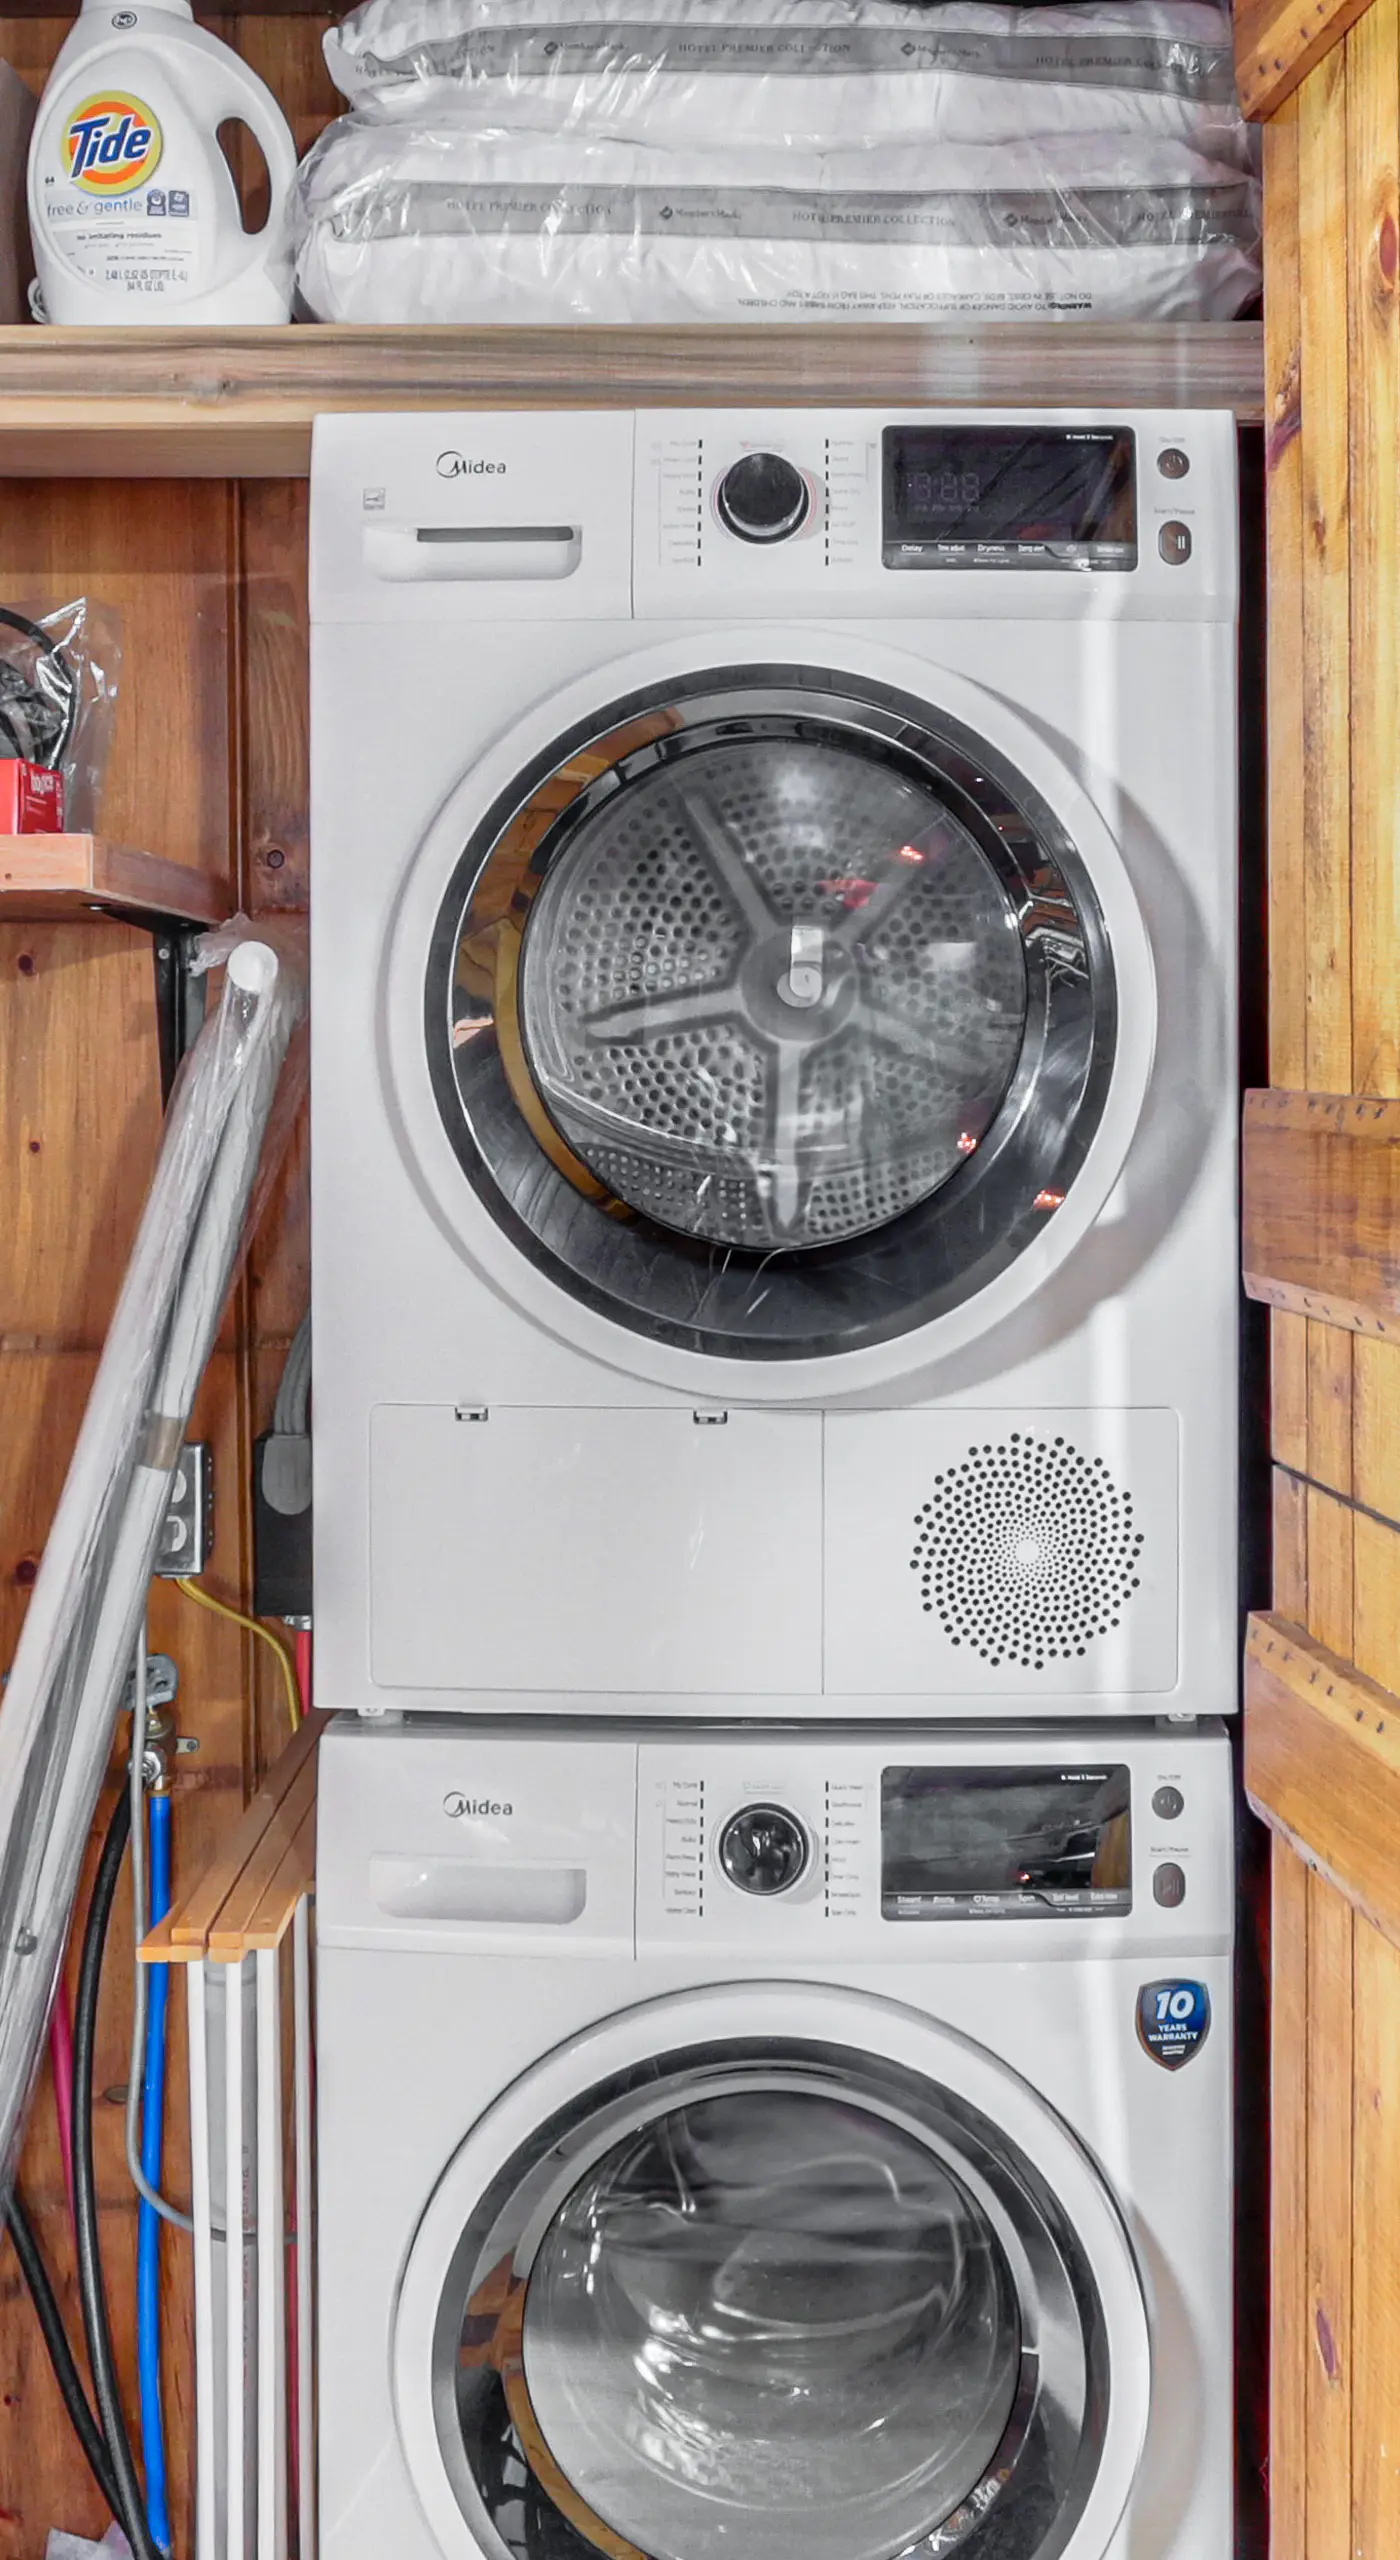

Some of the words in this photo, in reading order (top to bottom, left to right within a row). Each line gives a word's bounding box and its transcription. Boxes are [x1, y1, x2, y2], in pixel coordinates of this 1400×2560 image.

[679, 43, 716, 53] HOTEL
[721, 43, 774, 54] PREMIER
[778, 43, 851, 53] COLLTION
[1035, 56, 1075, 67] HOTEL
[1079, 56, 1133, 67] PREMIER
[69, 116, 152, 179] Tide
[47, 203, 74, 217] free
[76, 201, 91, 215] &
[94, 198, 143, 215] gentle
[831, 214, 882, 225] PREMIER
[882, 214, 956, 227] COLLECTION
[436, 450, 507, 479] Midea
[902, 544, 923, 553] Delay
[977, 544, 1005, 553] Dryness
[443, 1791, 513, 1818] Midea
[1156, 1990, 1194, 2020] 10
[1158, 2023, 1188, 2032] YEARS
[1148, 2031, 1198, 2042] WARRANTY
